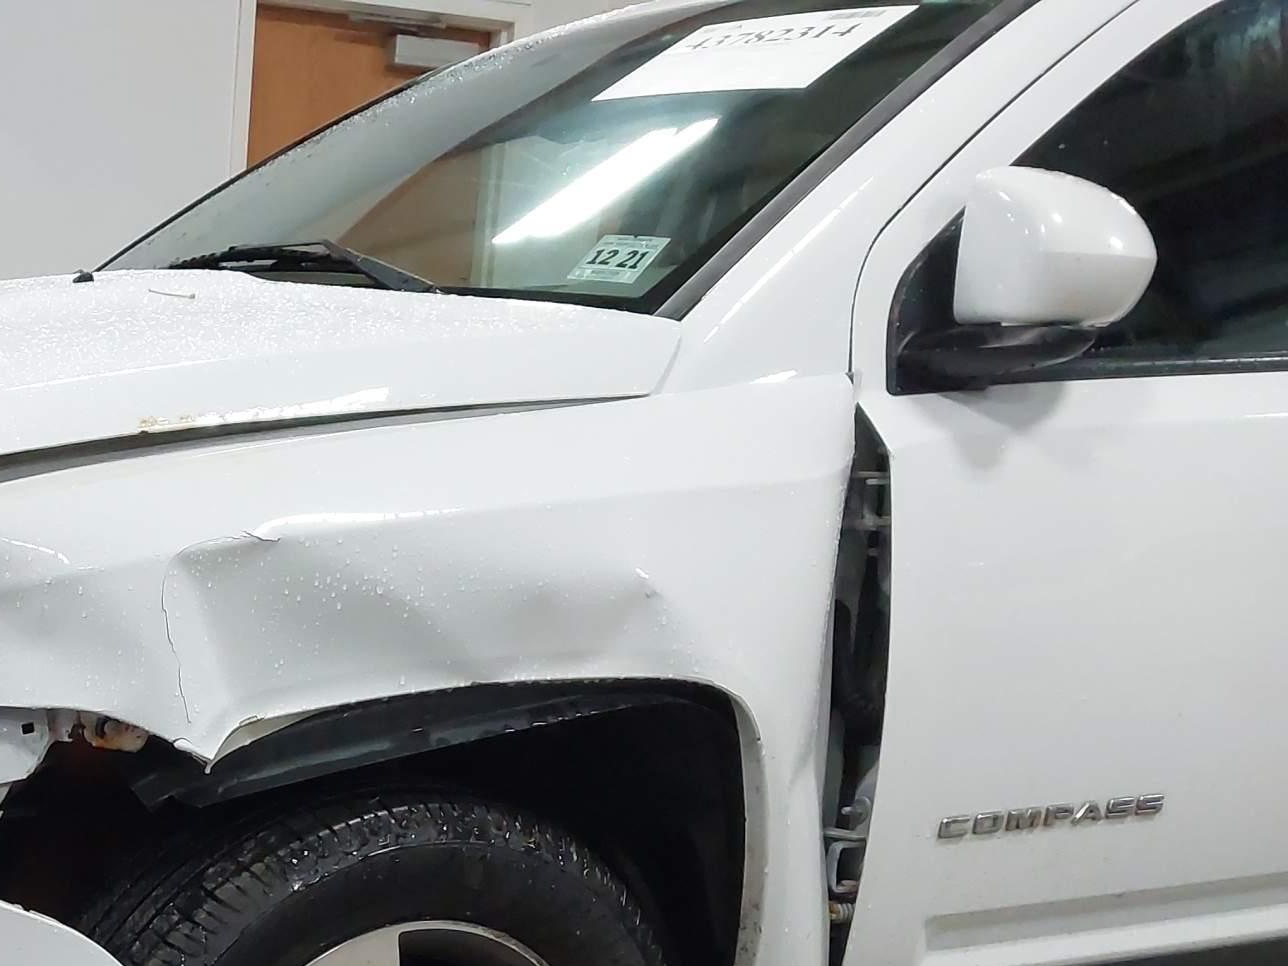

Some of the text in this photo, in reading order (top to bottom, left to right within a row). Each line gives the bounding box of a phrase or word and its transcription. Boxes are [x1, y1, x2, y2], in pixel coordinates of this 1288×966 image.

[686, 22, 862, 50] 43782314
[586, 248, 649, 270] 12 21
[937, 793, 1165, 839] COMPASS
